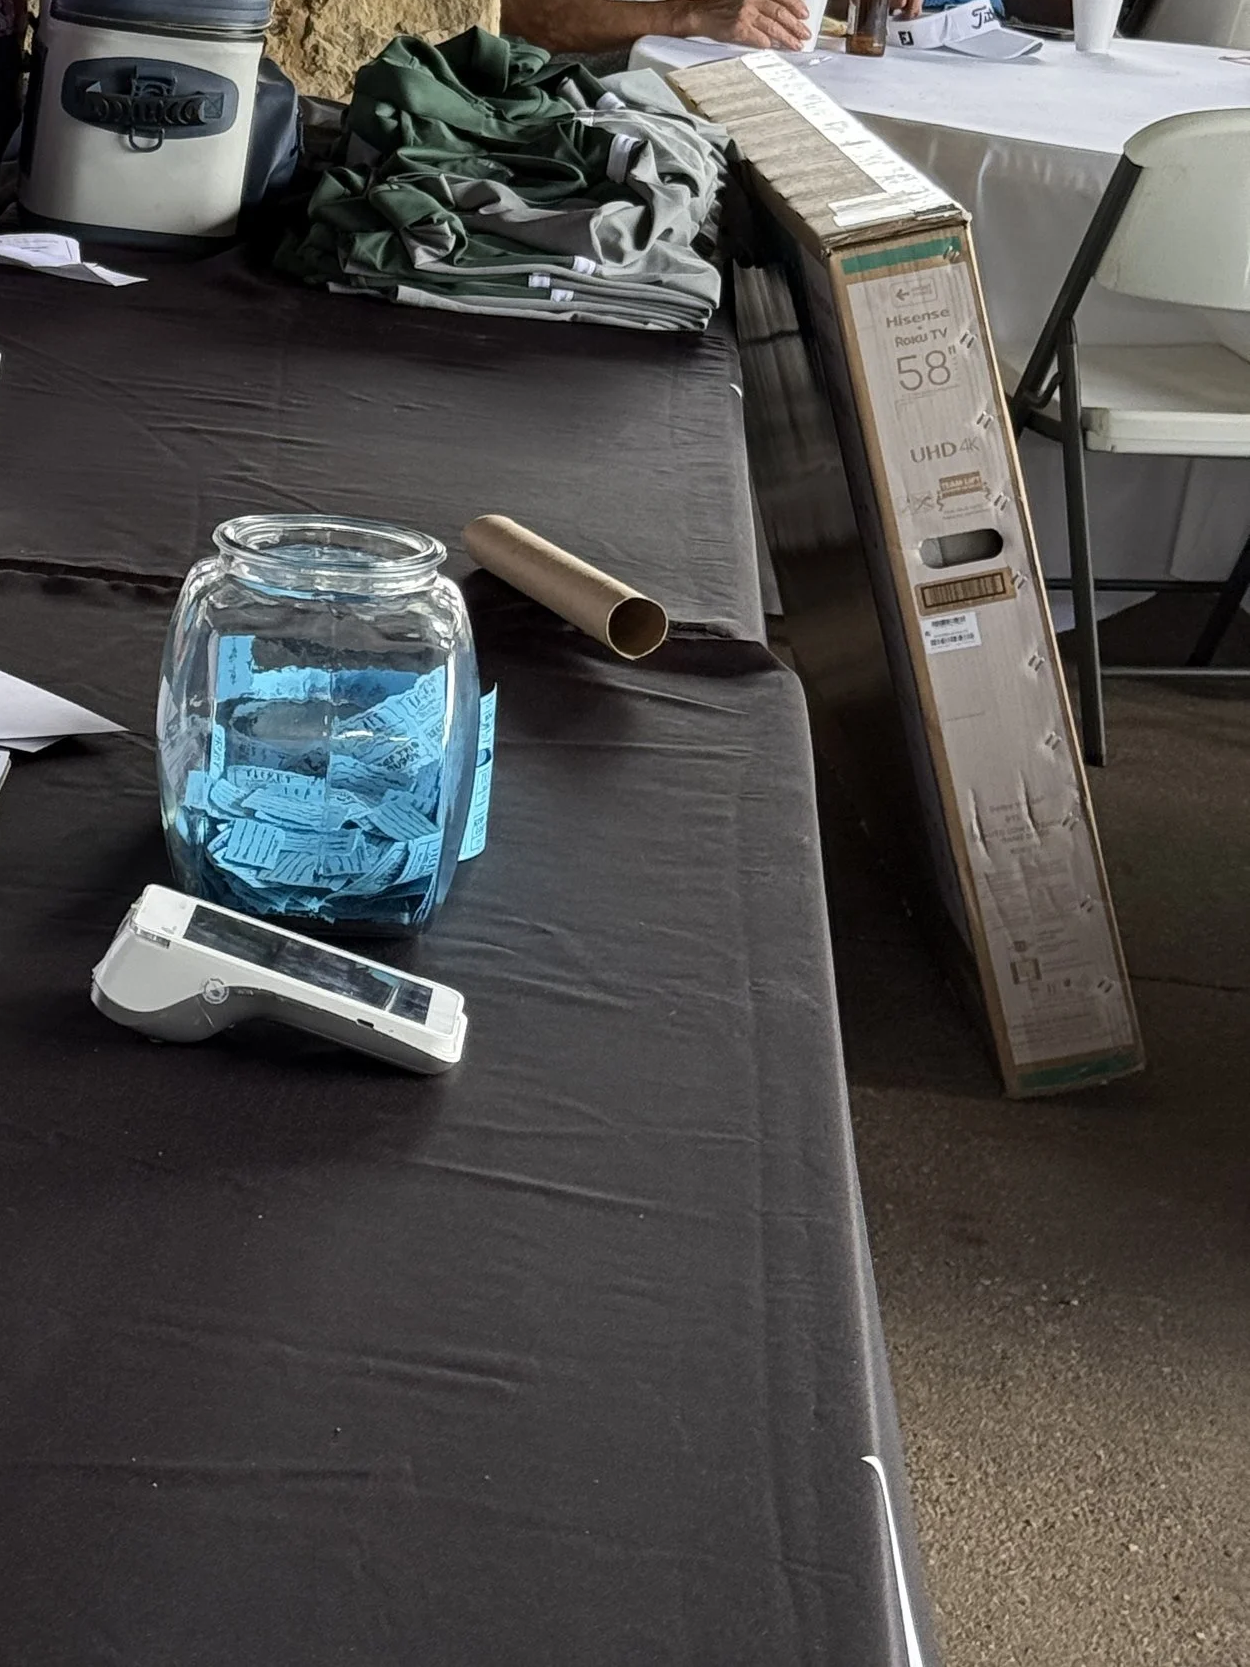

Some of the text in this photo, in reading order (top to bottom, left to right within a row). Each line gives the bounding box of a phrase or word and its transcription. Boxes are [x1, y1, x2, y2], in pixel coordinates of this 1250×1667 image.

[885, 308, 951, 328] Hisense
[895, 327, 948, 348] Roku TV
[910, 436, 980, 463] UHD 4K
